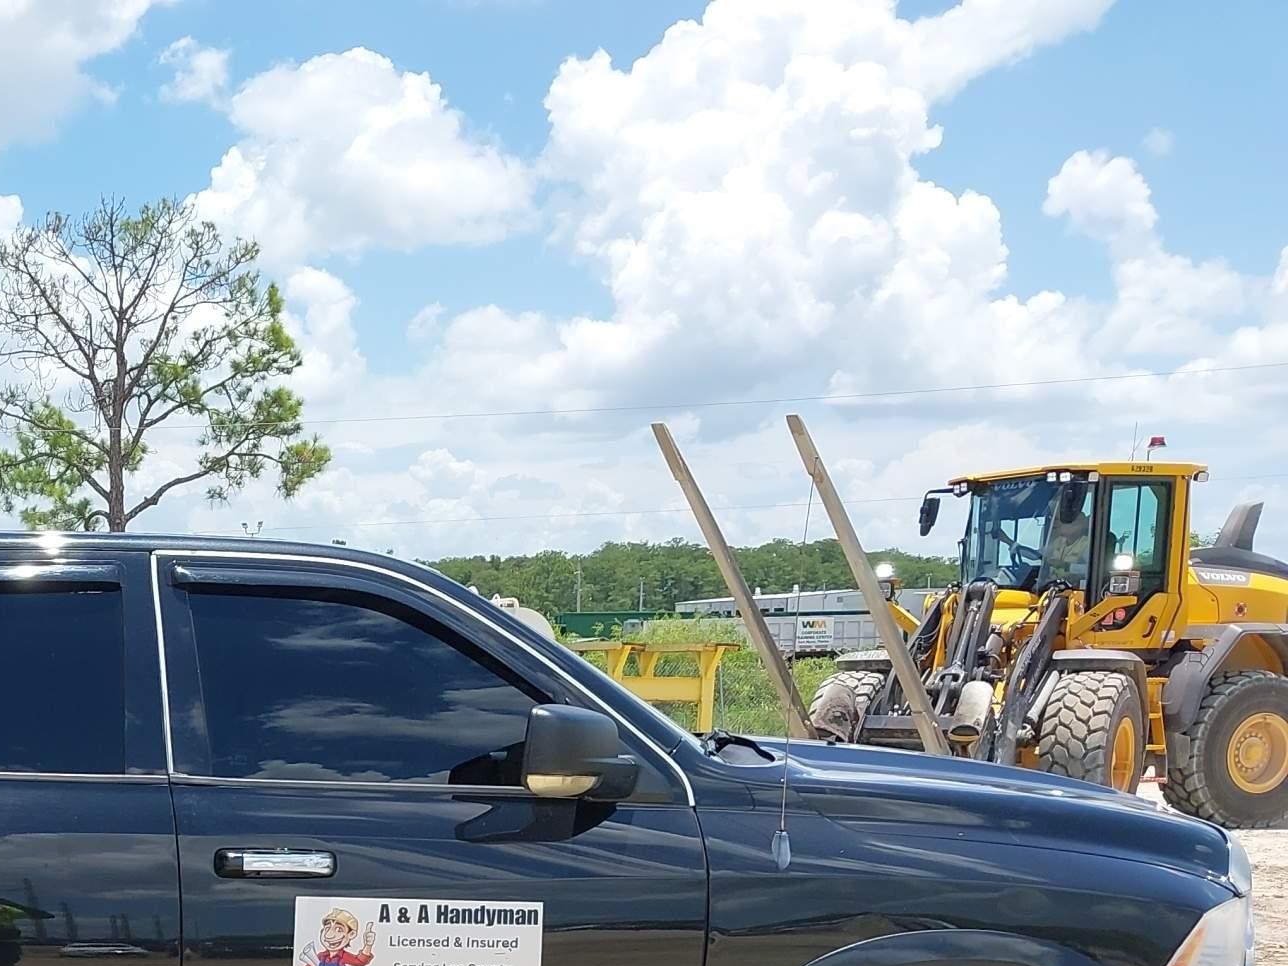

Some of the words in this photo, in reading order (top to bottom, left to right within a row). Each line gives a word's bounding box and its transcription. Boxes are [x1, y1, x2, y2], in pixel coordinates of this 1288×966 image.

[1198, 572, 1247, 582] VOLVO
[802, 620, 826, 628] WM
[378, 903, 391, 923] A
[397, 906, 411, 924] &
[417, 904, 430, 924] A
[436, 904, 539, 927] Handyman
[389, 935, 450, 948] Licensed
[453, 937, 463, 948] &
[466, 937, 519, 949] Insured
